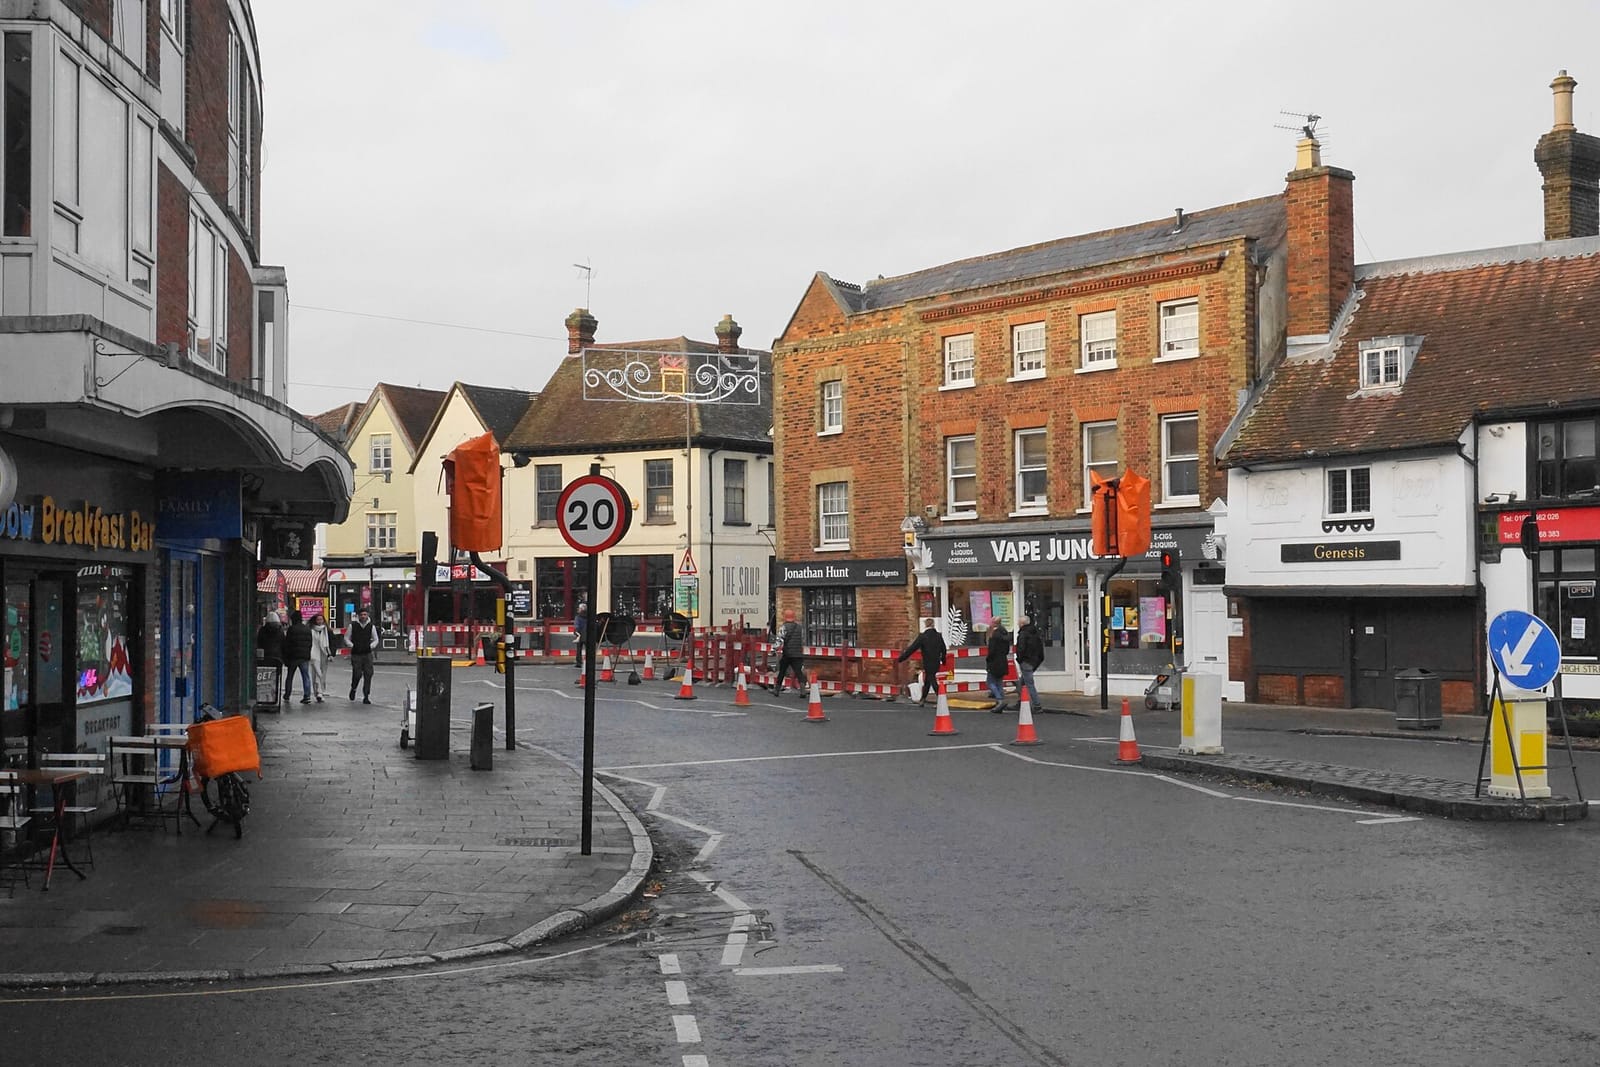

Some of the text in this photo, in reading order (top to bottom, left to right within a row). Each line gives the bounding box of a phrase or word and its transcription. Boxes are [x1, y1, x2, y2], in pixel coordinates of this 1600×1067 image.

[160, 499, 211, 512] FAMILY
[568, 499, 614, 531] 20
[42, 495, 125, 552] Breakfast
[131, 510, 155, 552] Bar
[990, 538, 1121, 562] VAPE JUN
[1314, 545, 1365, 559] Genesis
[947, 556, 978, 564] ACCESSORIES
[721, 566, 735, 596] THE
[784, 566, 849, 581] Jonathan Hunt
[881, 569, 899, 578] Agents
[1561, 665, 1580, 673] HIGH
[84, 714, 120, 736] BREAKFAST
